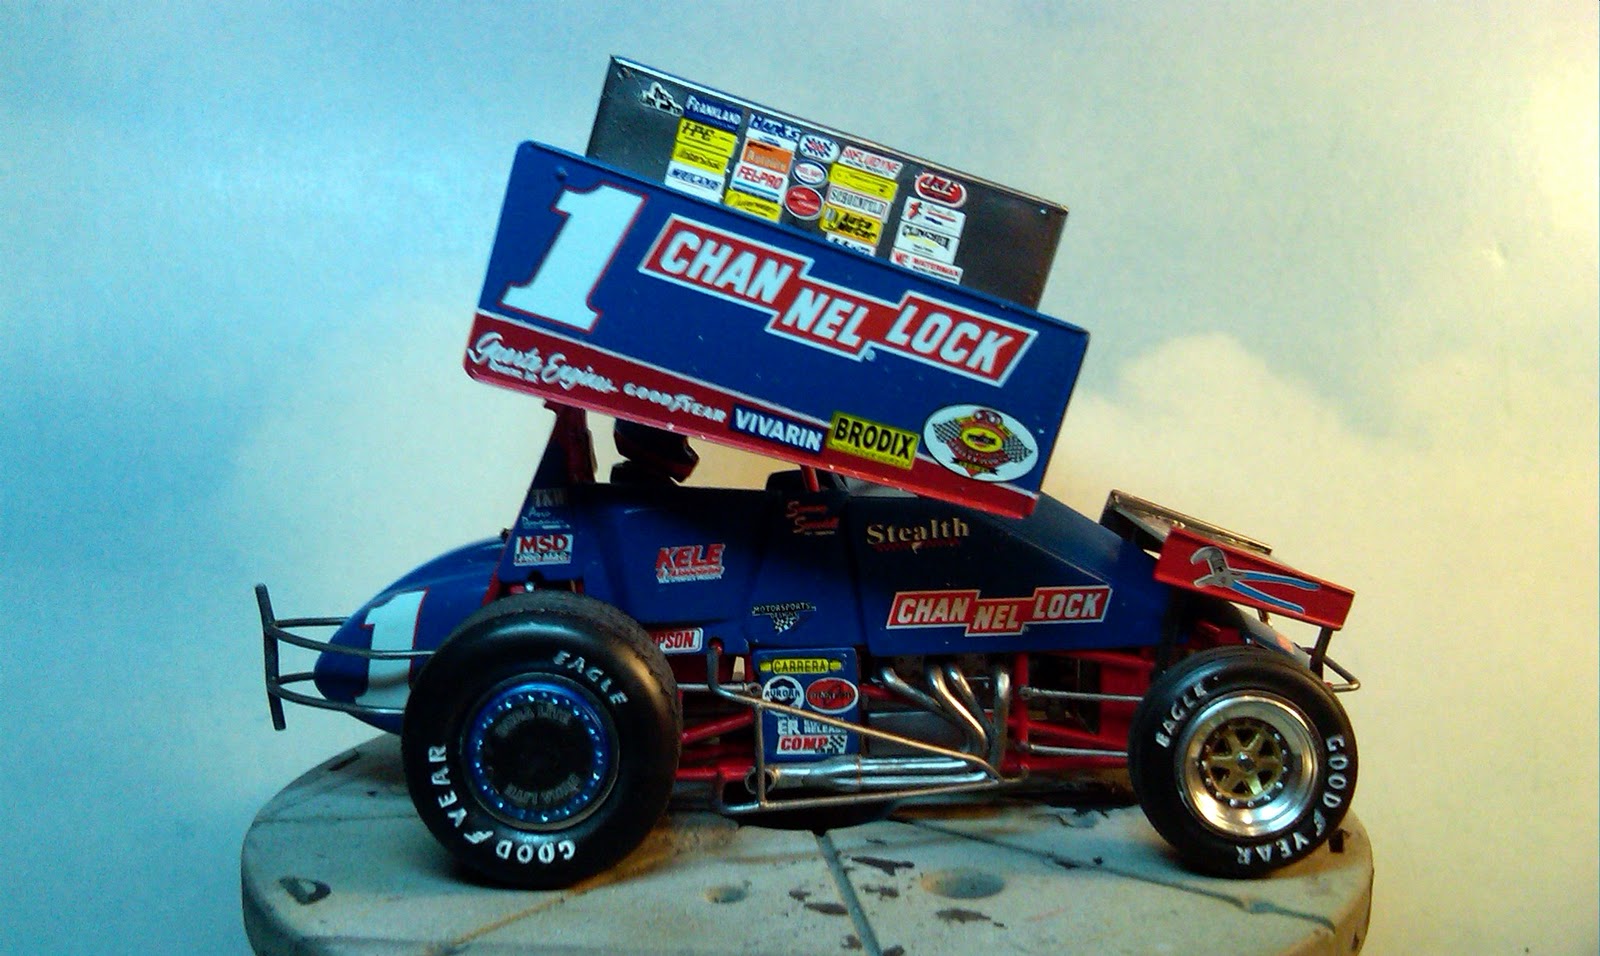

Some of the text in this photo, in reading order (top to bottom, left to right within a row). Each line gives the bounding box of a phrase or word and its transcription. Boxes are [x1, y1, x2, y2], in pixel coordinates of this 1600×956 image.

[498, 181, 649, 333] 1
[659, 229, 1014, 374] CHAN NEL LOCK
[734, 408, 823, 452] VIVARIN
[834, 417, 914, 460] BRODIX
[519, 534, 569, 553] MSD
[866, 517, 971, 546] Stealth
[655, 543, 726, 571] KELE
[896, 593, 1101, 631] CHAN NEL LOCK
[354, 588, 430, 711] 1
[652, 630, 696, 649] PSON
[553, 649, 629, 706] EAGLE
[774, 660, 827, 673] CARRERA
[780, 735, 829, 751] COMP
